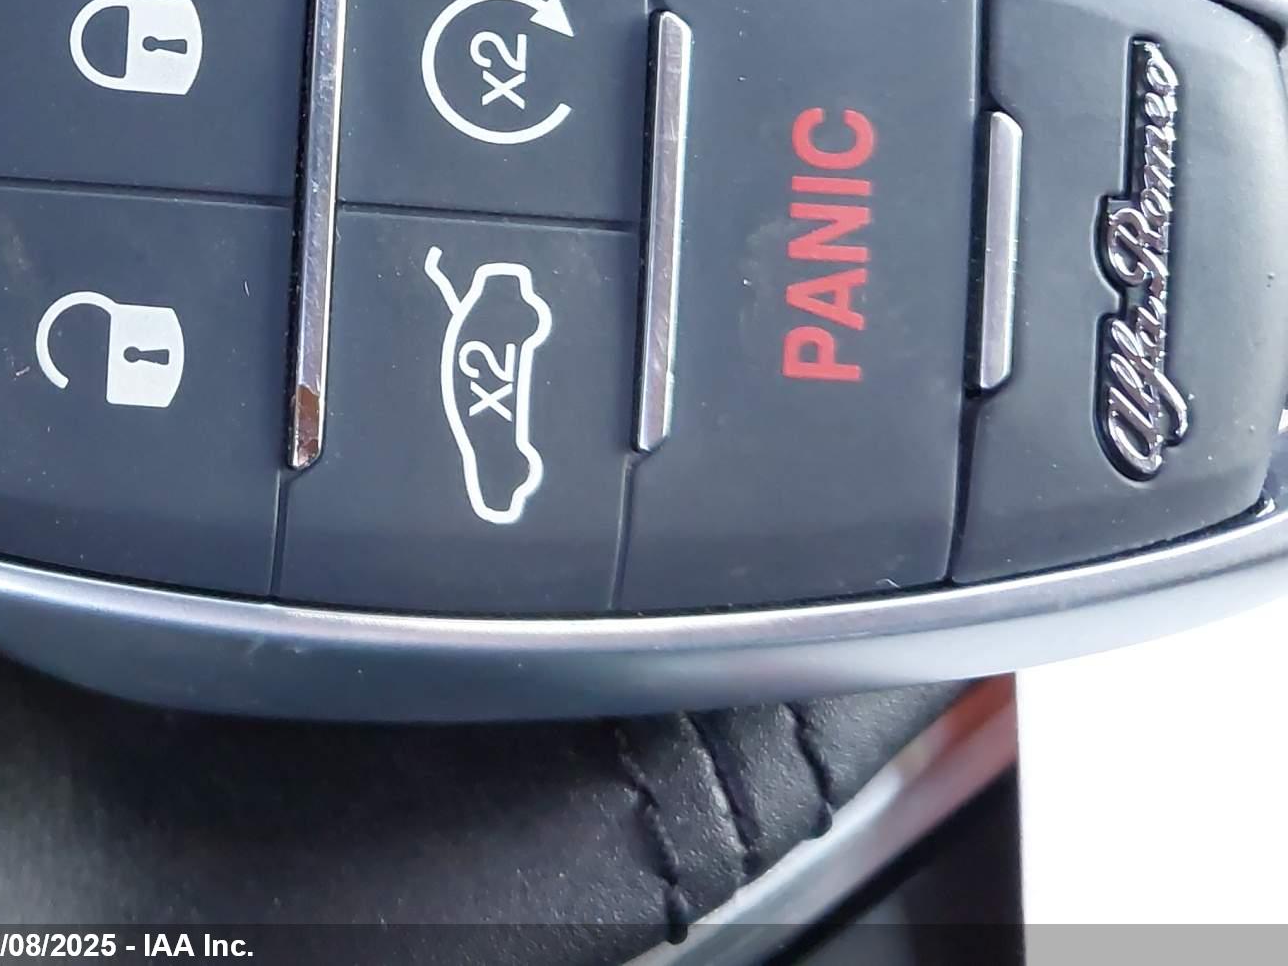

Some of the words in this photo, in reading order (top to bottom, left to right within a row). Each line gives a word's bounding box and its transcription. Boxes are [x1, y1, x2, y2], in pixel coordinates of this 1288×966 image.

[469, 29, 527, 110] x2
[782, 106, 877, 382] PANIC
[1105, 40, 1180, 288] Romeo
[457, 338, 515, 422] x2
[1106, 295, 1189, 474] Alfa
